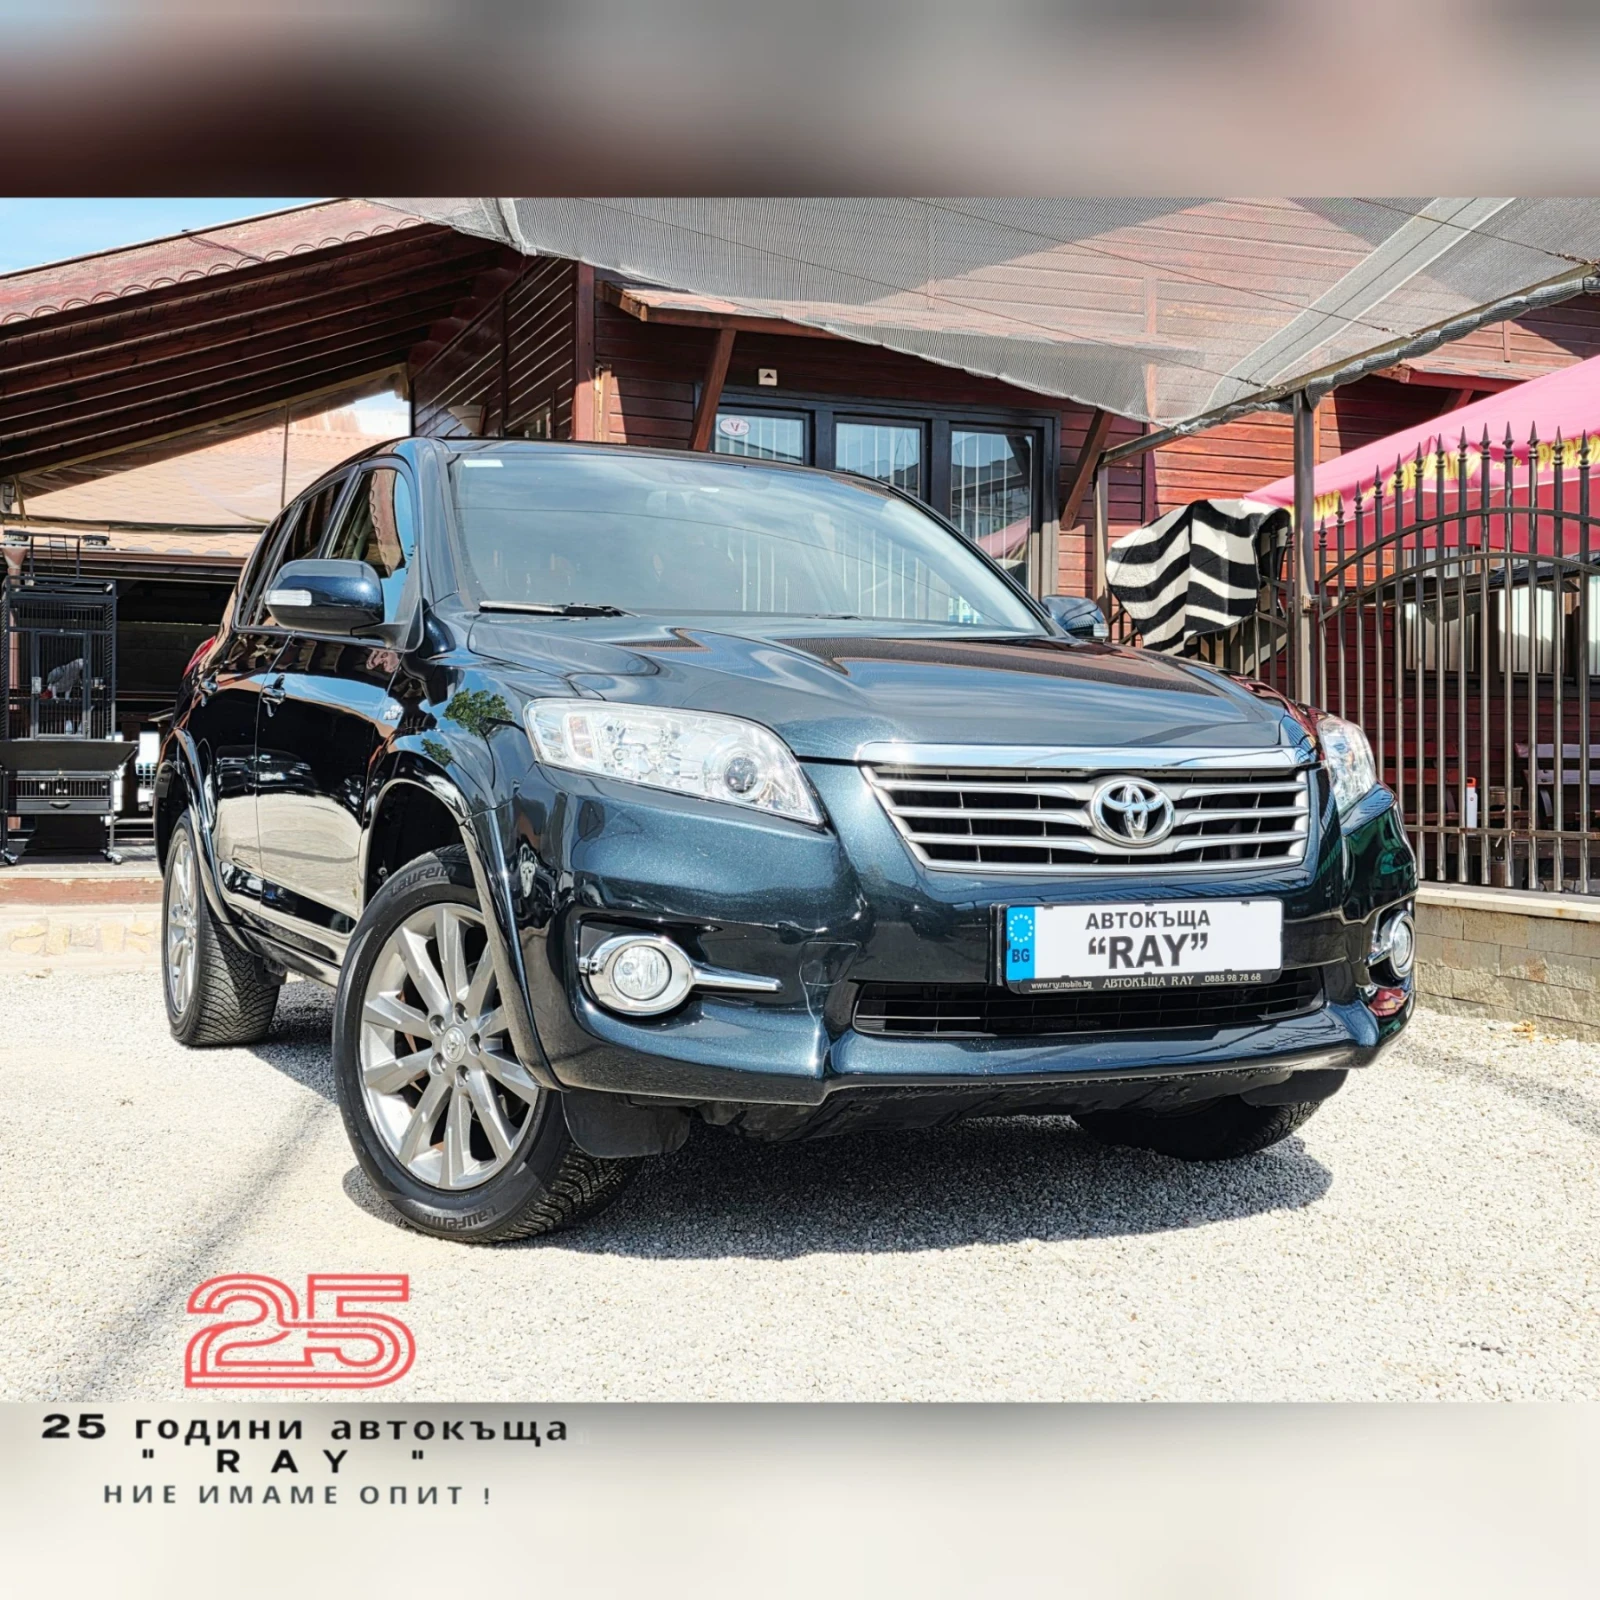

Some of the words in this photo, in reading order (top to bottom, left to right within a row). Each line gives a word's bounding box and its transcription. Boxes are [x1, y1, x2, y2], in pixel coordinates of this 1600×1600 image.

[1085, 909, 1212, 931] АВТОКЪЩА
[1011, 948, 1031, 963] BG
[1102, 974, 1166, 989] АВТОКЪЩА
[1171, 975, 1195, 987] RAY
[1204, 974, 1225, 983] 0885
[1227, 974, 1237, 982] 98
[1239, 973, 1249, 981] 78
[1251, 972, 1262, 981] 68
